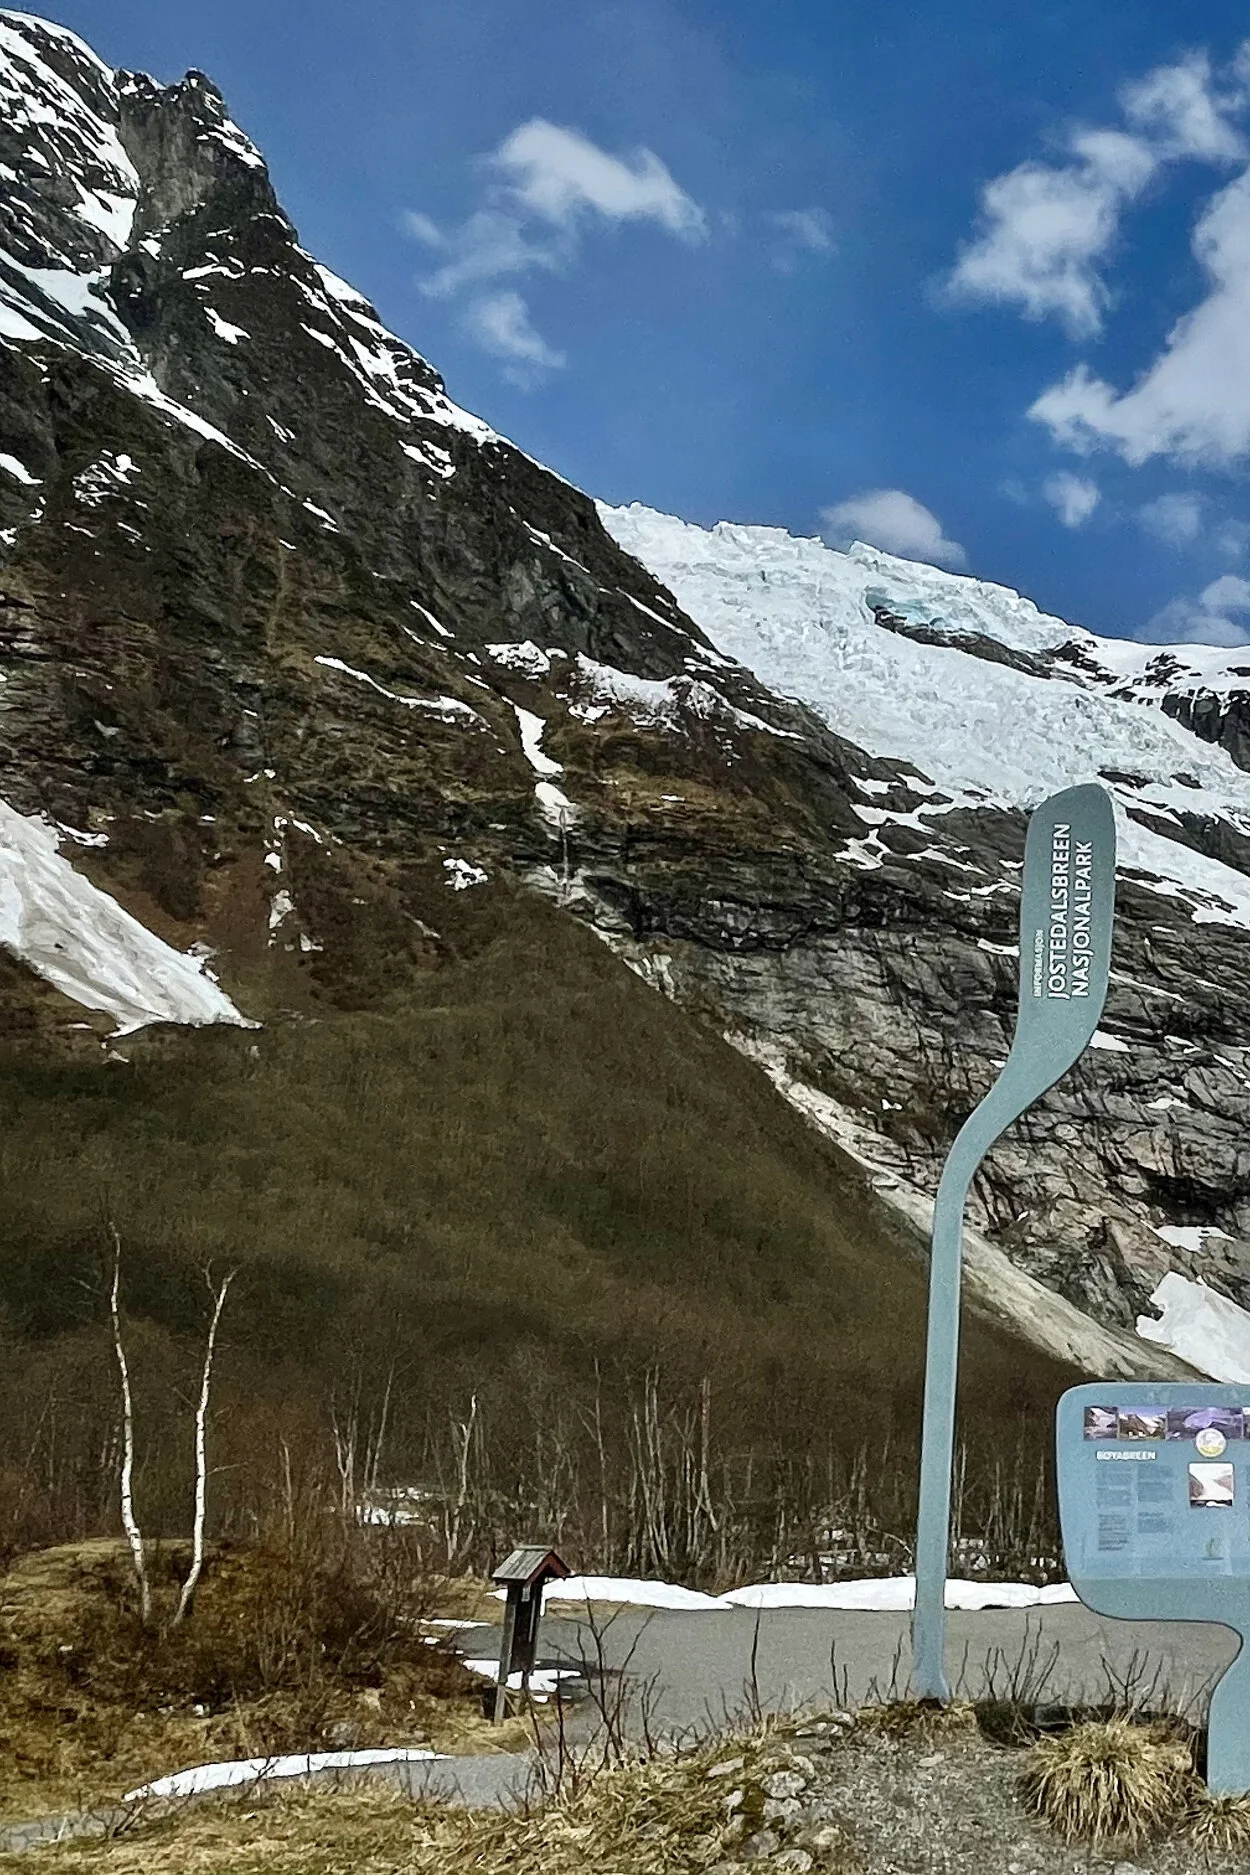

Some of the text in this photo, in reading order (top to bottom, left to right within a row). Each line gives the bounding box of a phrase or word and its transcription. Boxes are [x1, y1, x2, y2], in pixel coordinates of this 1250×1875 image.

[1033, 929, 1045, 998] INFORMASJON
[1048, 823, 1071, 1000] JOSTEDALSBREEN
[1071, 841, 1094, 997] NASJONALPARK
